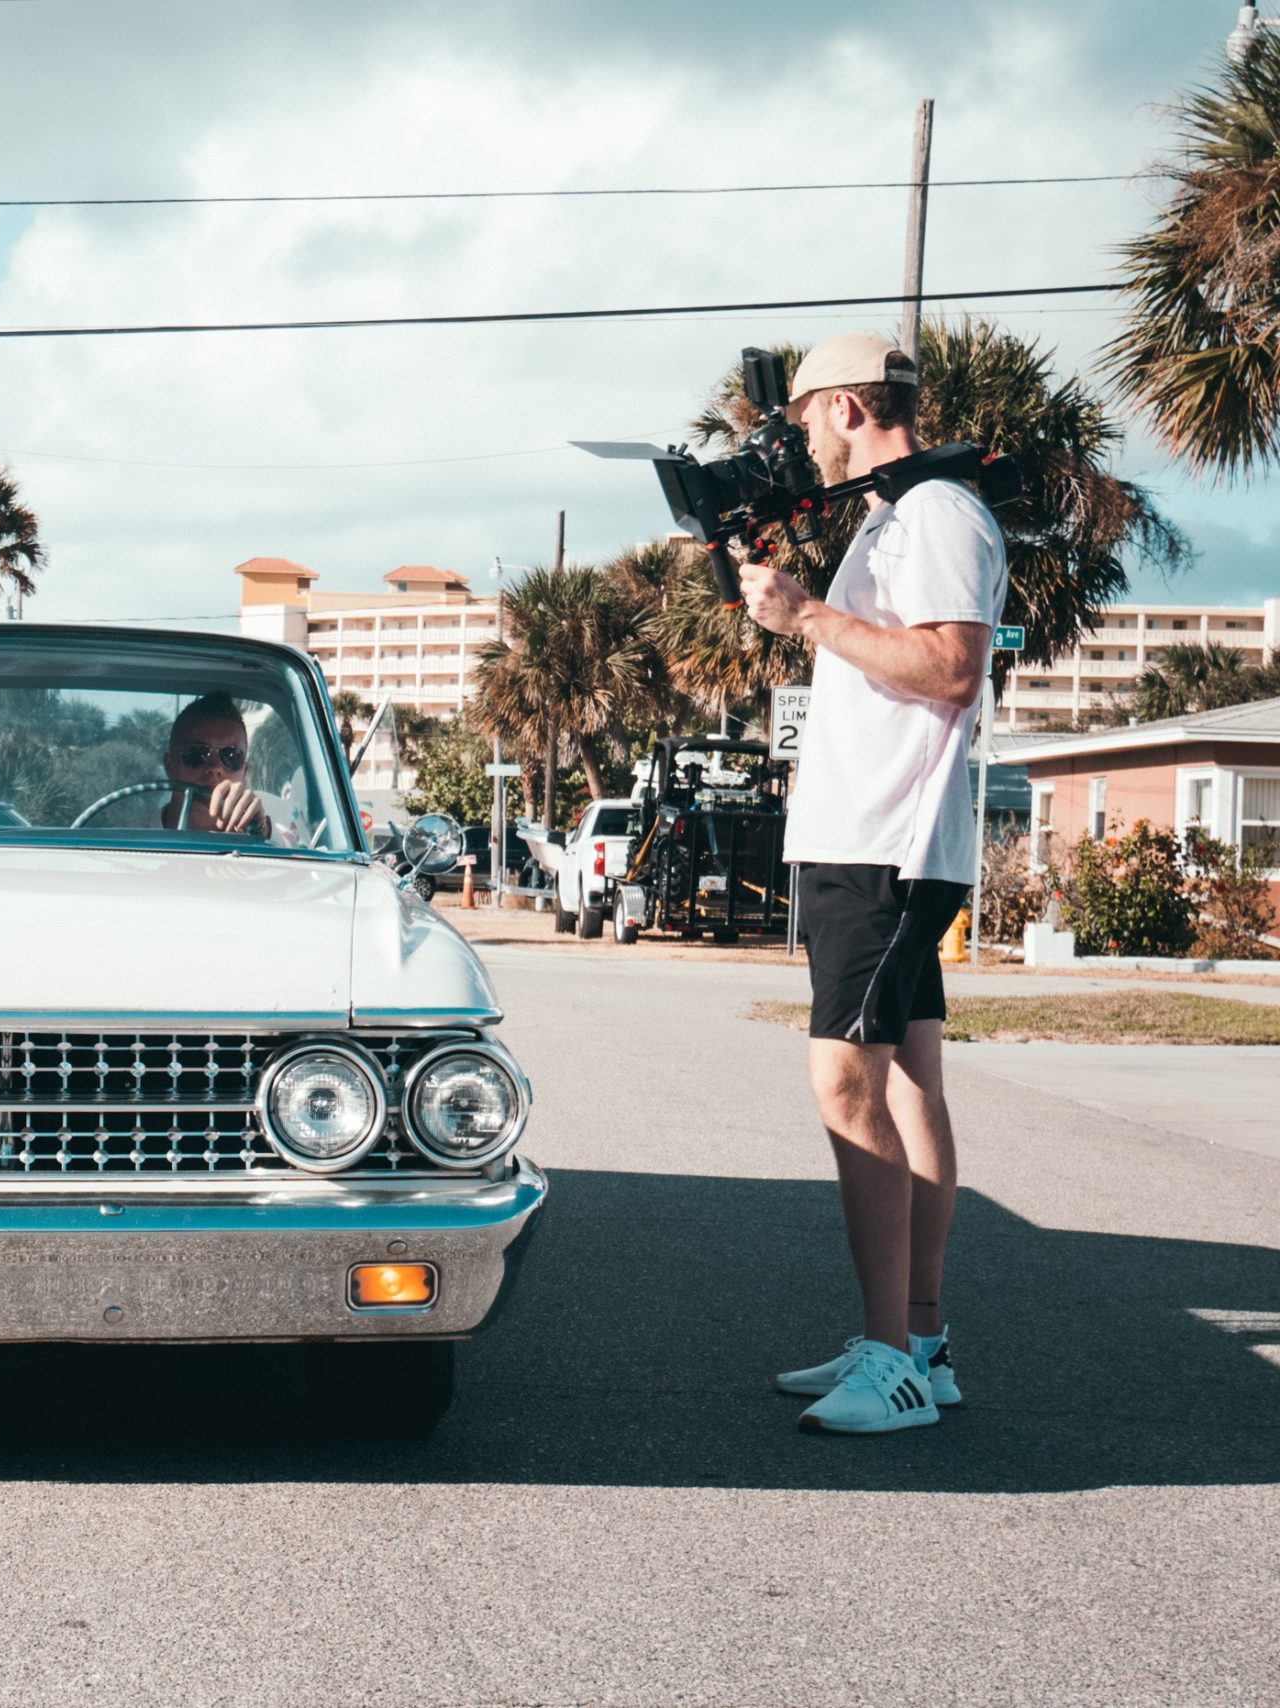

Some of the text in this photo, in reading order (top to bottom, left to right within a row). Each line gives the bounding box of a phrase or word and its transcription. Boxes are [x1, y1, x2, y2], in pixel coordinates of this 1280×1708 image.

[995, 630, 1019, 646] a Ave
[778, 695, 810, 707] SPE
[782, 710, 807, 721] LIM
[778, 725, 798, 750] 2
